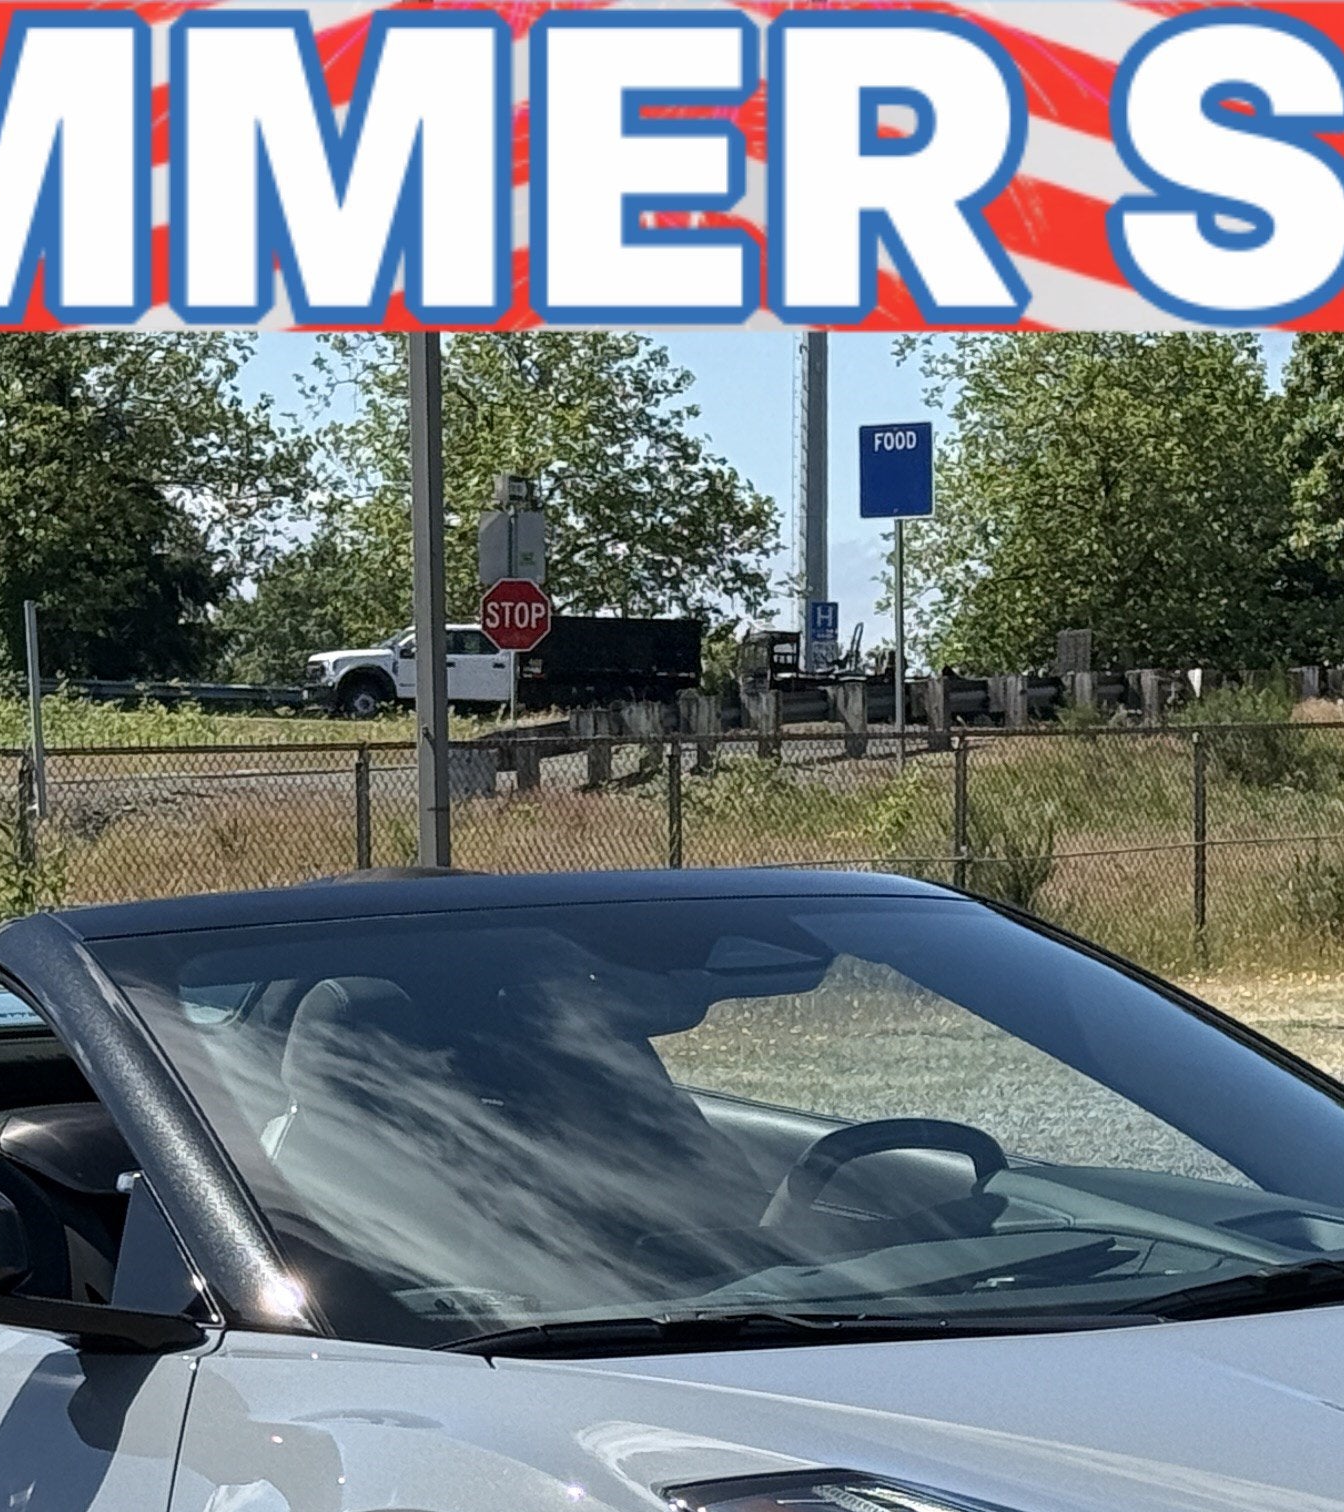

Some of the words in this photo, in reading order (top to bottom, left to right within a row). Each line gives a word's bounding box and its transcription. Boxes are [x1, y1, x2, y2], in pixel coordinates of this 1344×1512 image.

[874, 430, 917, 452] FOOD
[485, 602, 546, 629] STOP
[816, 605, 834, 628] H
